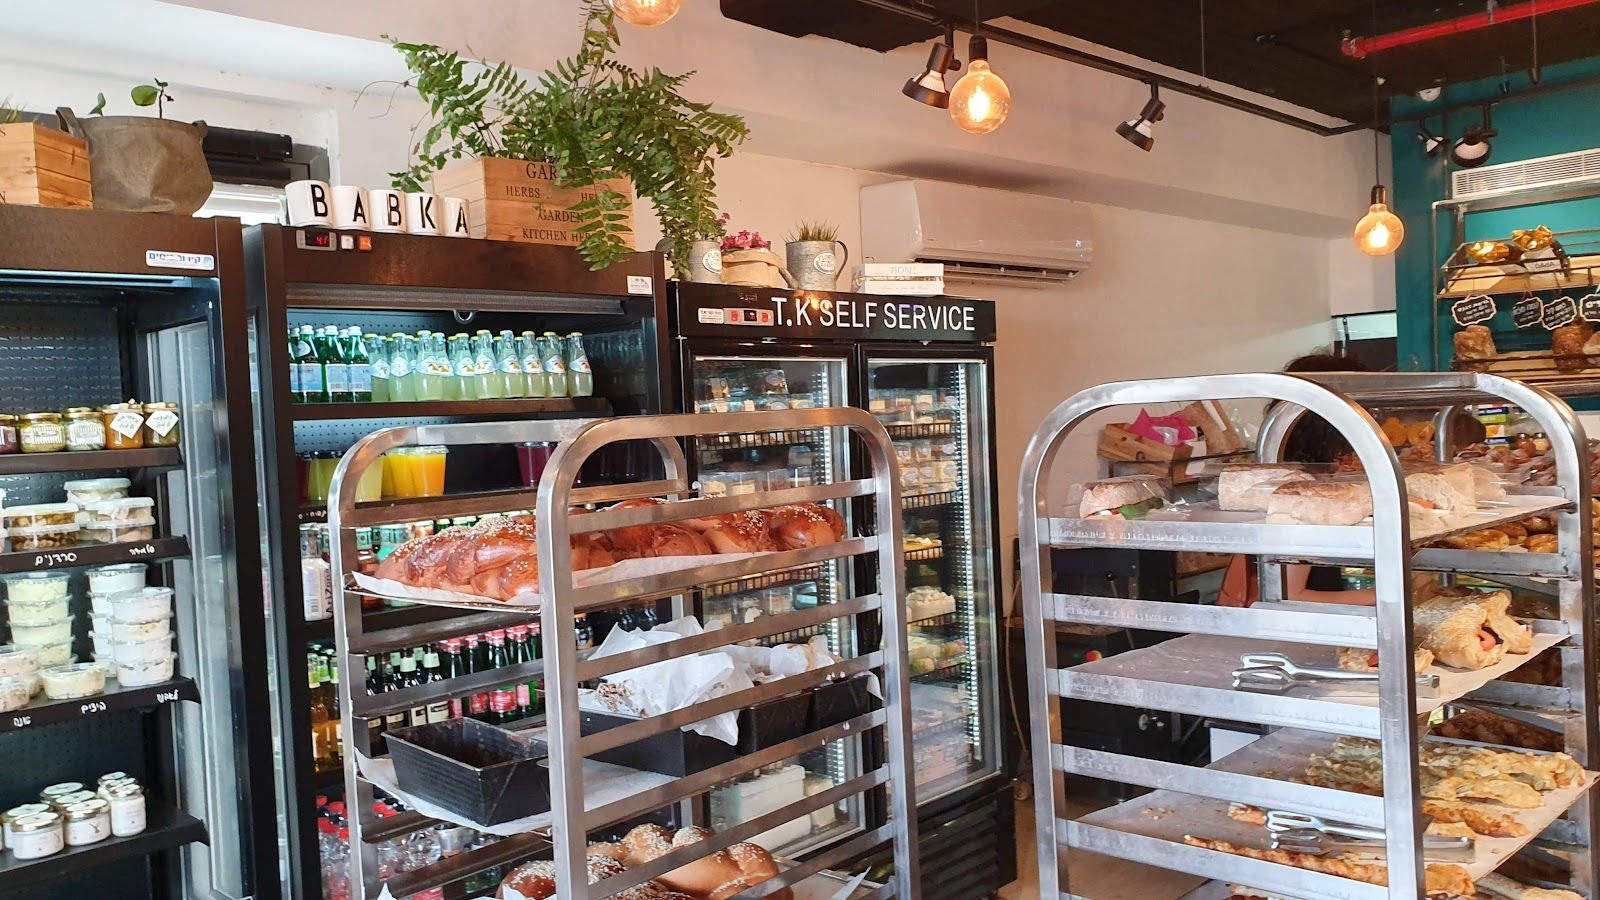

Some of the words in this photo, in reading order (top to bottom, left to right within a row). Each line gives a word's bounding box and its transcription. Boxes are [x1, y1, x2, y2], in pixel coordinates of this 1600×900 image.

[526, 162, 558, 180] GAR
[505, 186, 541, 199] HERBS
[522, 228, 567, 241] KITCHEN
[771, 296, 812, 327] T.K
[819, 299, 878, 328] SELF
[883, 302, 976, 331] SERVICE
